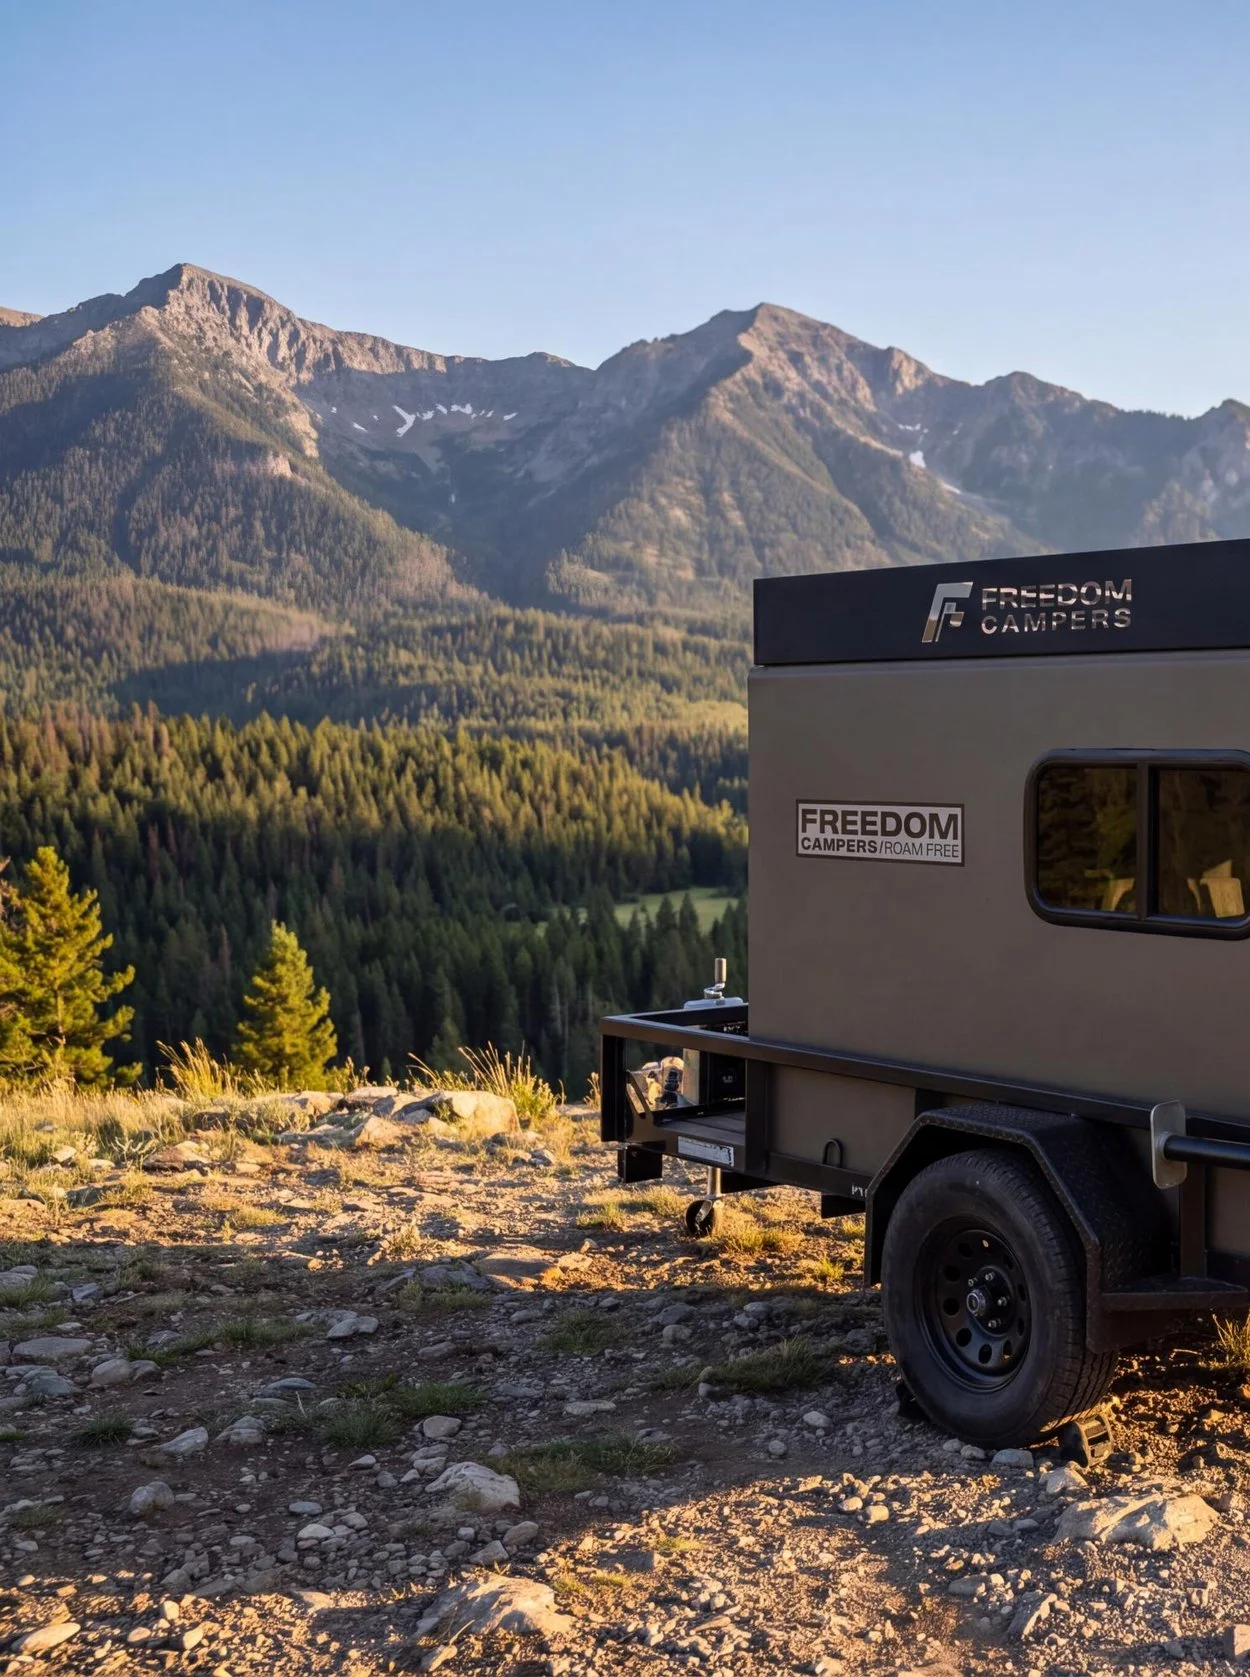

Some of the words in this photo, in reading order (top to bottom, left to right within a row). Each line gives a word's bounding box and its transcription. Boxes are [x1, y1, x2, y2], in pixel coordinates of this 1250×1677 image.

[981, 579, 1133, 611] FREEDOM
[981, 608, 1132, 635] CAMPERS
[801, 808, 959, 841] FREEDOM
[926, 842, 959, 858] FREE
